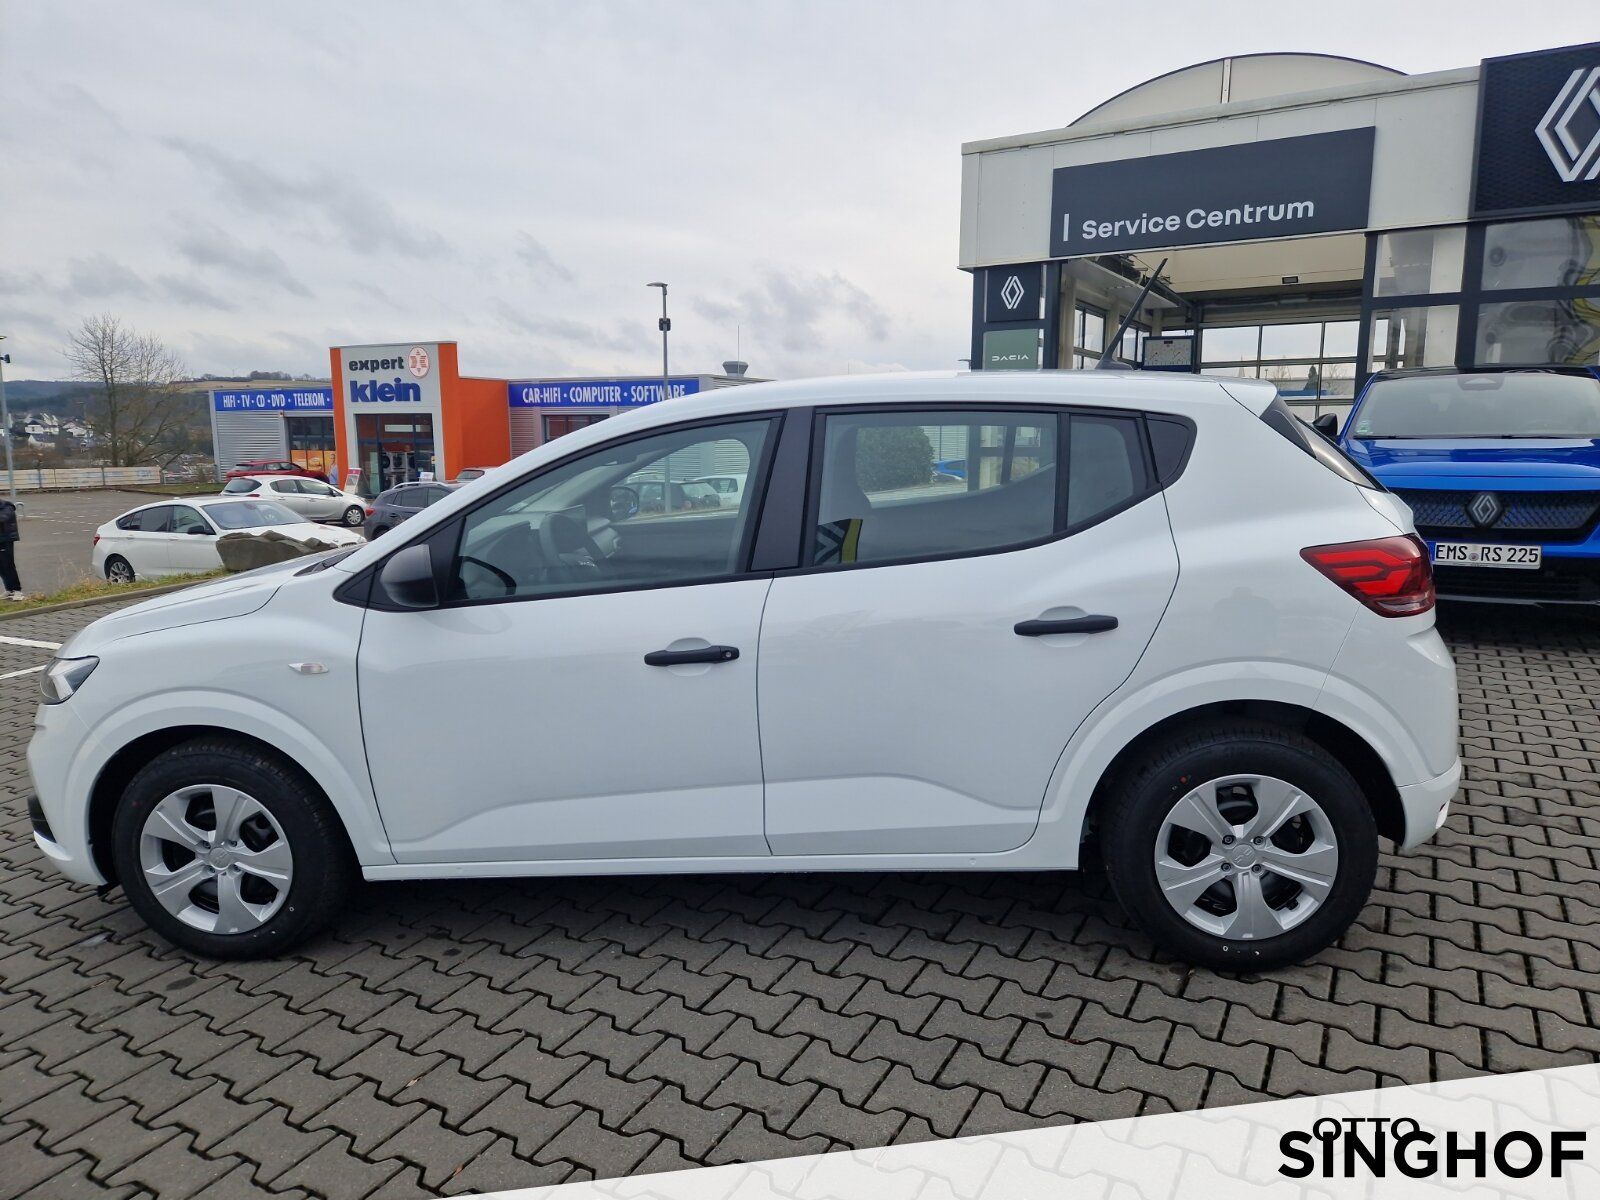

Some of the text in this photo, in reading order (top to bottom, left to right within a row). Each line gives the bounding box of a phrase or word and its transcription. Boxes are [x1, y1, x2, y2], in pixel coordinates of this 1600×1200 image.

[1082, 200, 1315, 239] Service Centrum
[349, 356, 405, 373] expert
[349, 377, 421, 402] klein
[522, 384, 685, 403] CAR-HIFI COMPUTER SOFTWARE
[223, 393, 325, 408] HIFI TV CD DVD TELEKOM
[1435, 544, 1539, 563] EMS RS 225
